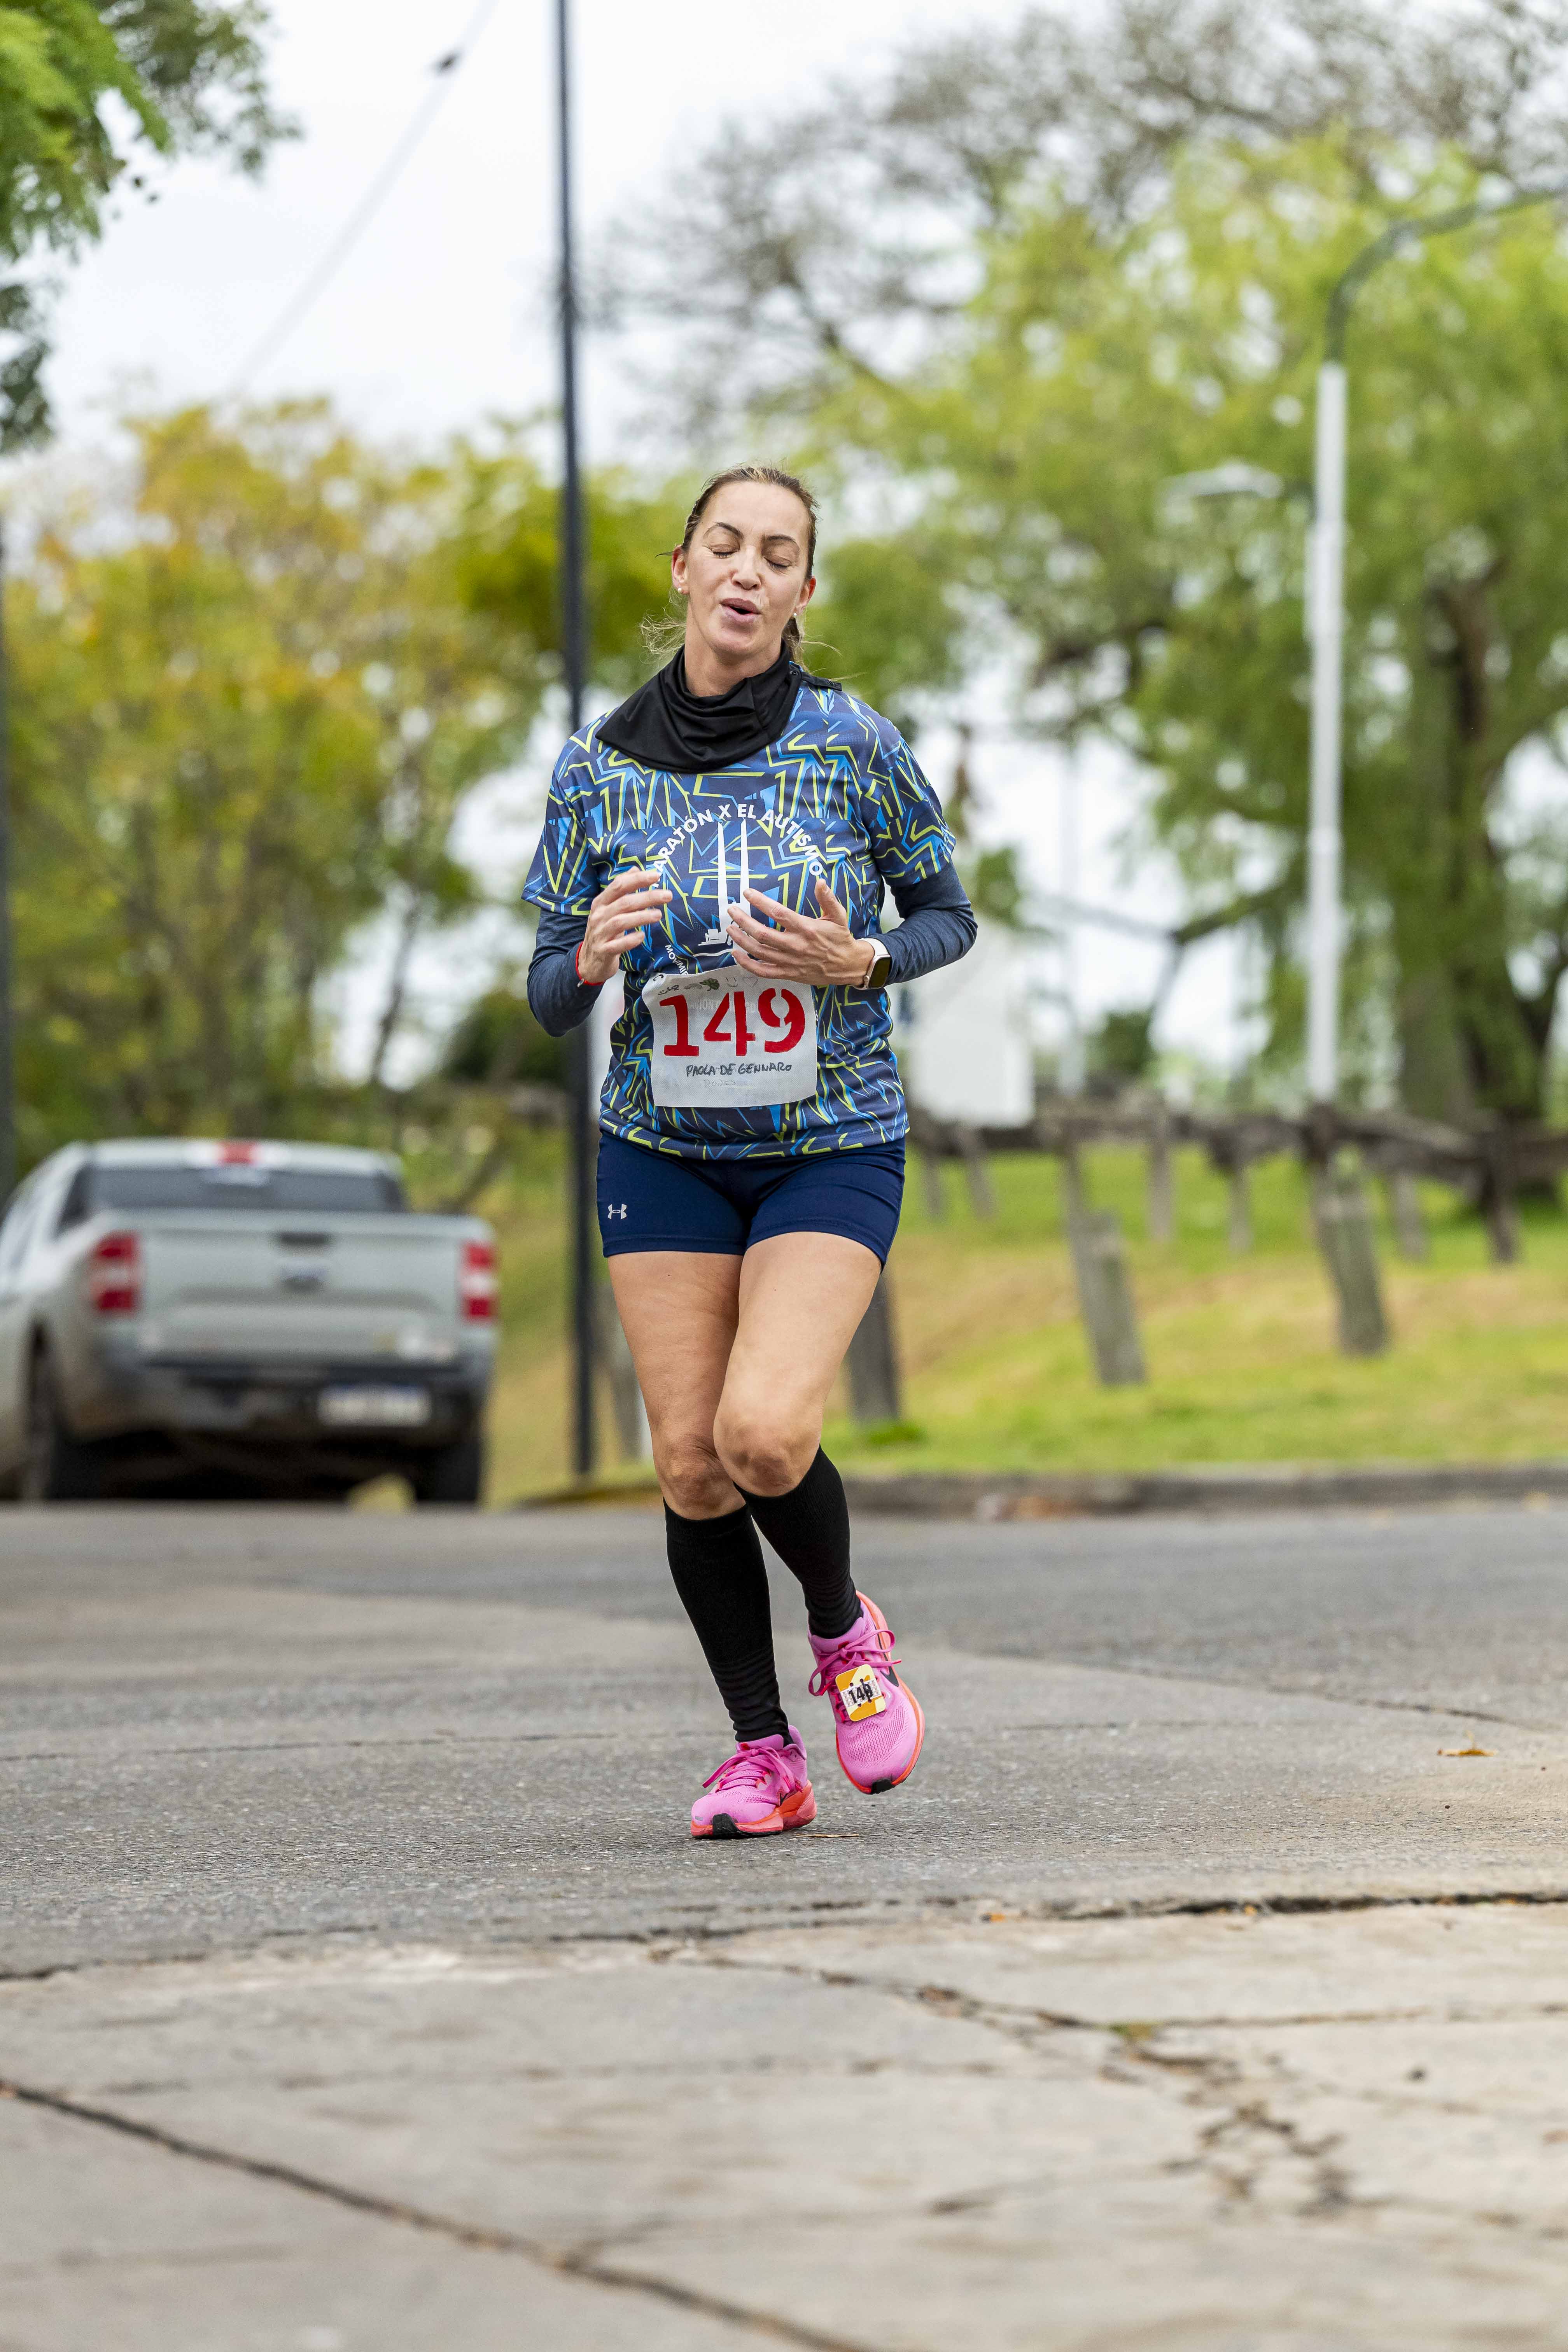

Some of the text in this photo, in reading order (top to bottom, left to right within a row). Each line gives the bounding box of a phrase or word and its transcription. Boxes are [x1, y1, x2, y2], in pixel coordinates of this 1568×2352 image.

[651, 803, 823, 888] ARATÓN X EL AUTISMO
[659, 988, 805, 1056] 149
[686, 1062, 792, 1077] PAOLA DE GENNARO
